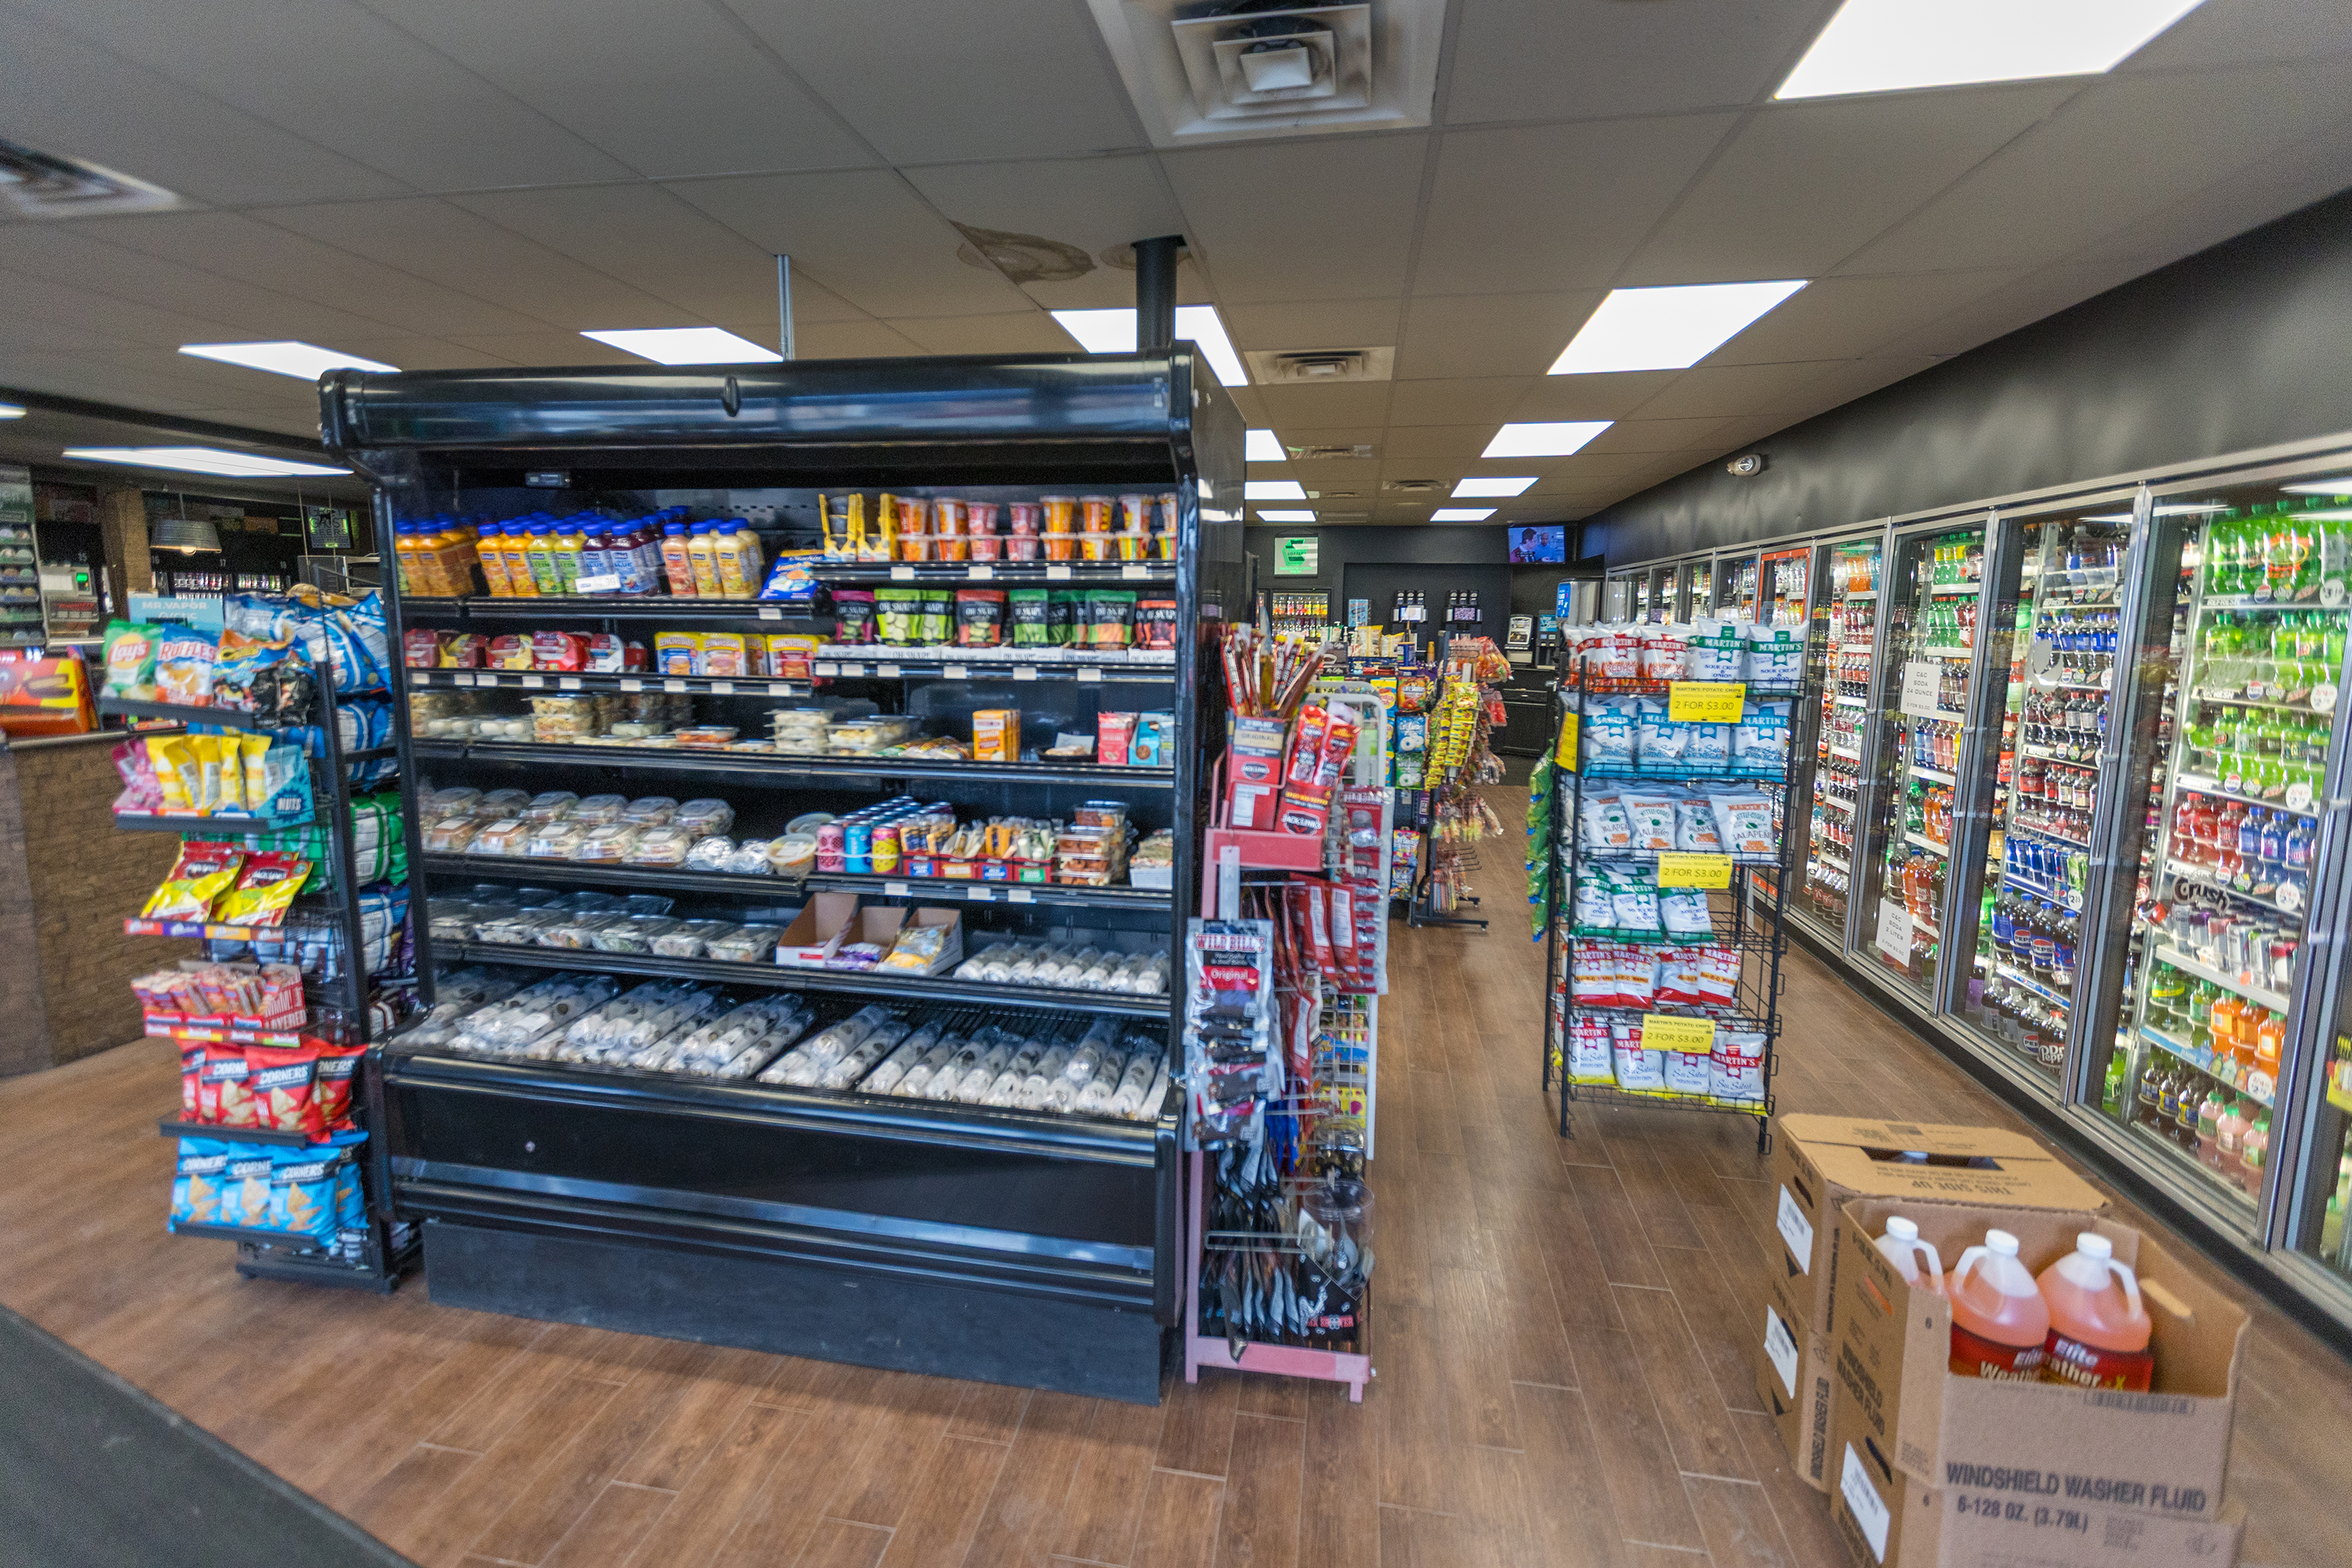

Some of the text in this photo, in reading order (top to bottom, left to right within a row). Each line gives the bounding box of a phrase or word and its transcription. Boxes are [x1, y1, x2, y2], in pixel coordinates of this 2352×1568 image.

[1602, 637, 1638, 647] MARTIN'S
[1650, 641, 1687, 650] MARTIN'S
[1705, 638, 1745, 648] MARTIN'S
[1759, 643, 1802, 652] MARTIN'S
[111, 641, 147, 662] Lay's
[158, 641, 216, 661] RUFFLES
[1675, 701, 1681, 710] 2
[1707, 701, 1734, 711] $3.00
[1664, 867, 1722, 878] 2 FOR $3.00
[2174, 875, 2229, 916] Crush
[1892, 913, 1902, 923] C&C
[1889, 920, 1903, 931] SODA
[1889, 929, 1904, 942] LITER
[1196, 935, 1225, 950] WILD
[2033, 944, 2055, 953] PEPSI
[1574, 950, 1612, 960] MARTIN'S
[1613, 951, 1653, 964] MARTIN'S
[1210, 968, 1249, 982] Original
[1656, 1033, 1675, 1041] FOR
[1677, 1033, 1704, 1044] $3.00
[1714, 1053, 1756, 1066] MARTIN'S
[2040, 1046, 2063, 1064] Pepp
[1912, 1179, 1933, 1190] UP
[1939, 1181, 1973, 1193] SIDE
[2054, 1338, 2099, 1367] Elite
[1945, 1461, 2060, 1496] WINDSHIELD
[2065, 1472, 2146, 1506] WASHER
[2150, 1483, 2208, 1513] FLUID
[1957, 1494, 2001, 1519] 6-128
[2004, 1501, 2030, 1523] OZ.
[2033, 1506, 2089, 1535] (3.79L)
